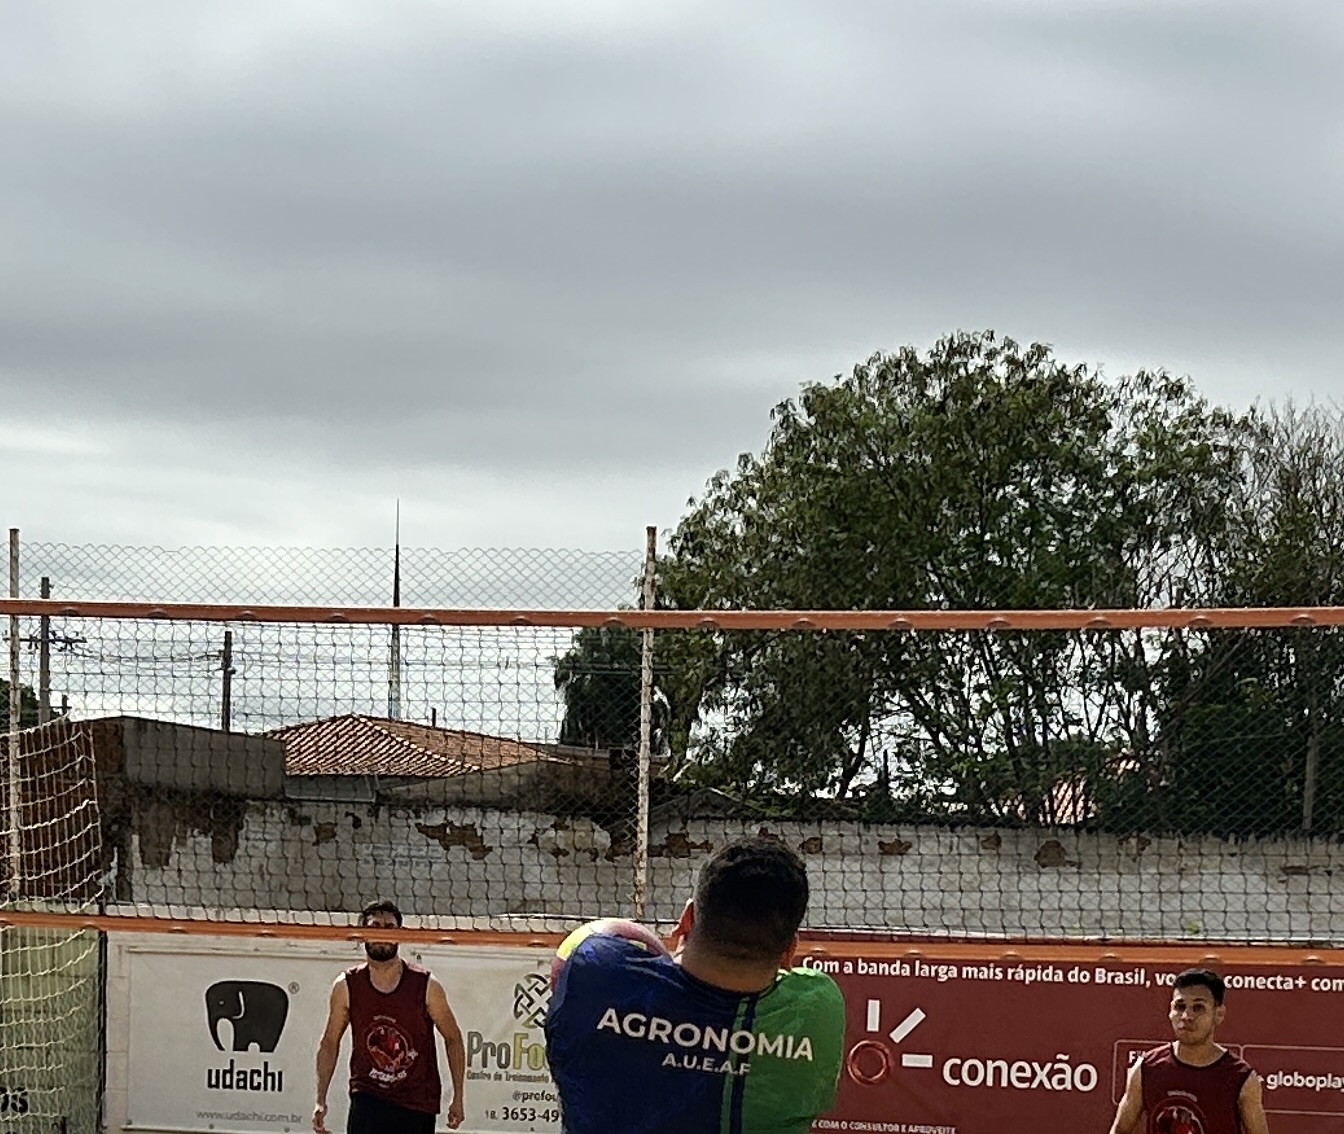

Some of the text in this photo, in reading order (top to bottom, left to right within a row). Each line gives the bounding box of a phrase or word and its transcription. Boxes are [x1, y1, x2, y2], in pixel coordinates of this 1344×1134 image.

[803, 957, 839, 973] Com
[843, 962, 853, 974] a
[858, 958, 910, 976] banda
[915, 960, 958, 982] larga
[962, 963, 1003, 980] mais
[1007, 965, 1063, 984] rápida
[1067, 966, 1090, 983] do
[1095, 968, 1150, 988] Brasil,
[1155, 973, 1175, 986] vo
[1223, 975, 1307, 991] conecta+
[467, 1031, 549, 1071] ProFo
[596, 1007, 814, 1062] AGRONOMIA
[207, 1058, 283, 1092] udachi
[661, 1052, 752, 1076] A.U.E.A.F
[942, 1053, 1098, 1091] conexão
[196, 1110, 304, 1124] www.udachi.com.br
[502, 1107, 560, 1122] 3653-49
